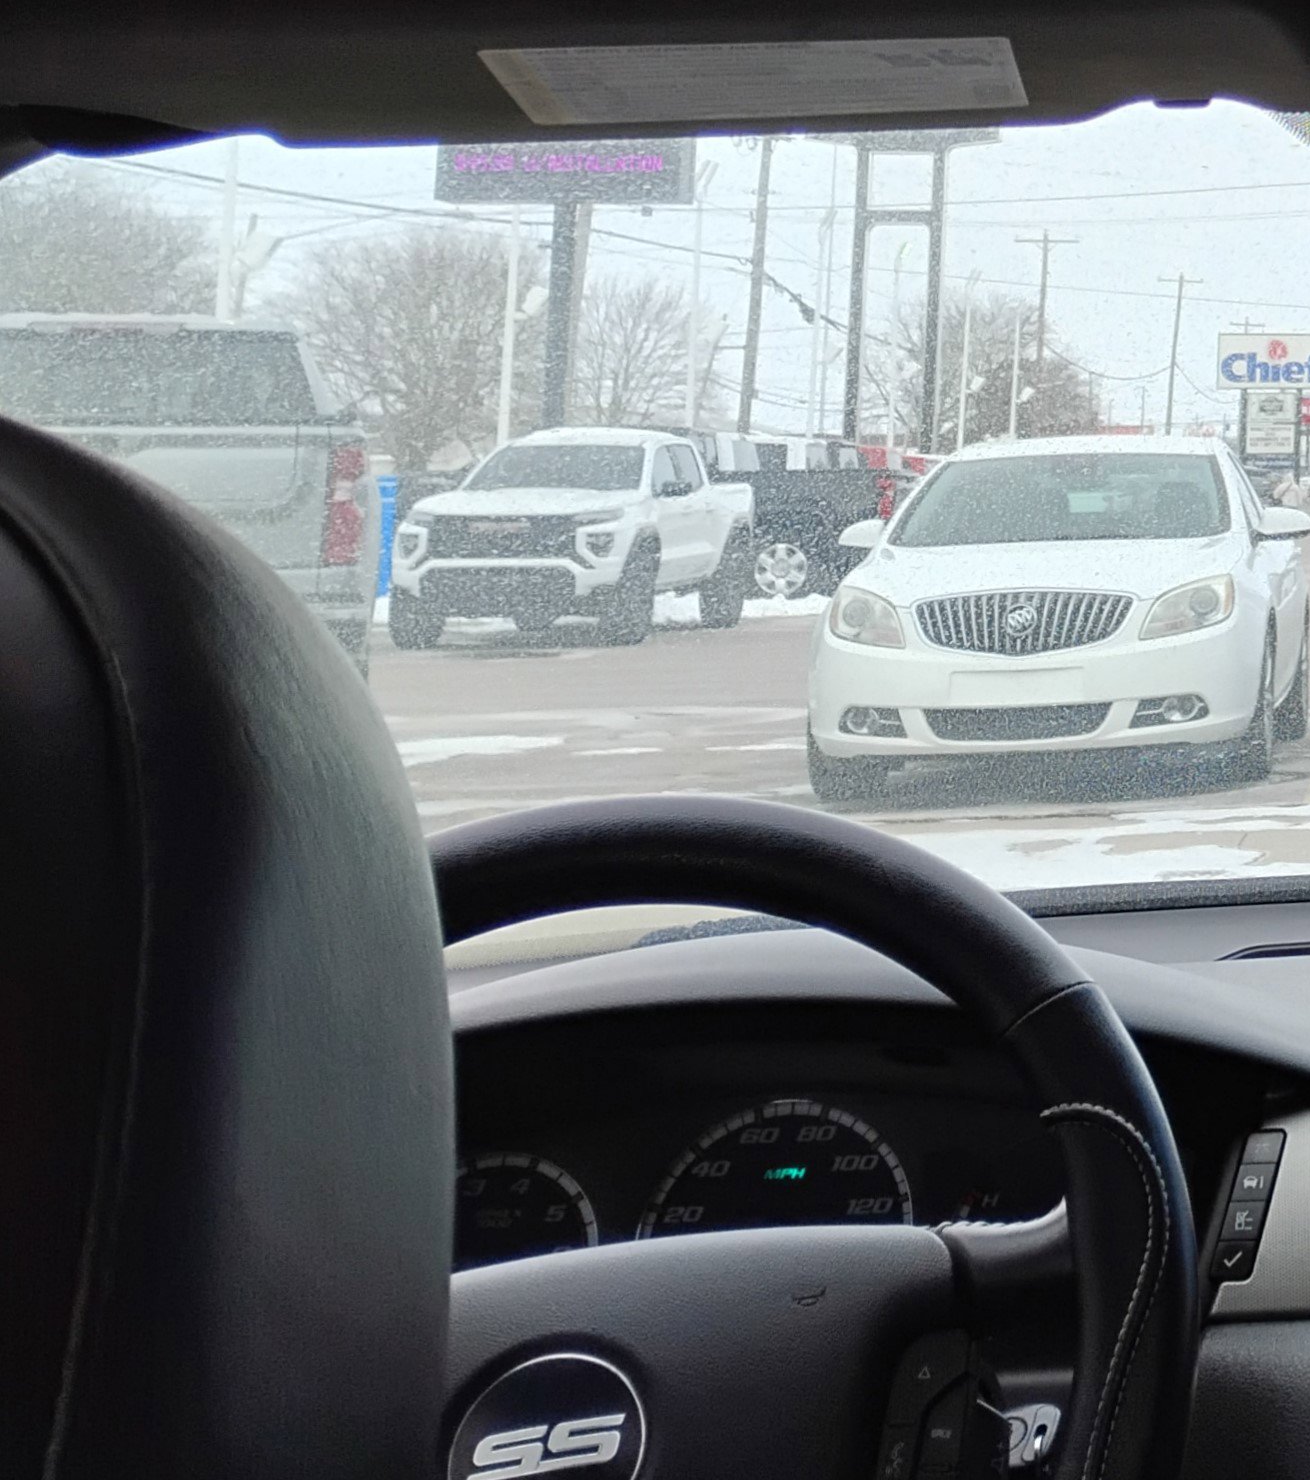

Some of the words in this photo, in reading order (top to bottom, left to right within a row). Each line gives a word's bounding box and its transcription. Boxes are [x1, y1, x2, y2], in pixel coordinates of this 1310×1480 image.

[739, 1126, 781, 1144] 60
[795, 1125, 838, 1142] 80
[691, 1161, 731, 1177] 40
[830, 1154, 880, 1171] 100
[763, 1167, 806, 1180] MPH
[545, 1205, 568, 1222] 5
[663, 1206, 704, 1223] 20
[846, 1197, 894, 1215] 120
[466, 1413, 627, 1480] SS
